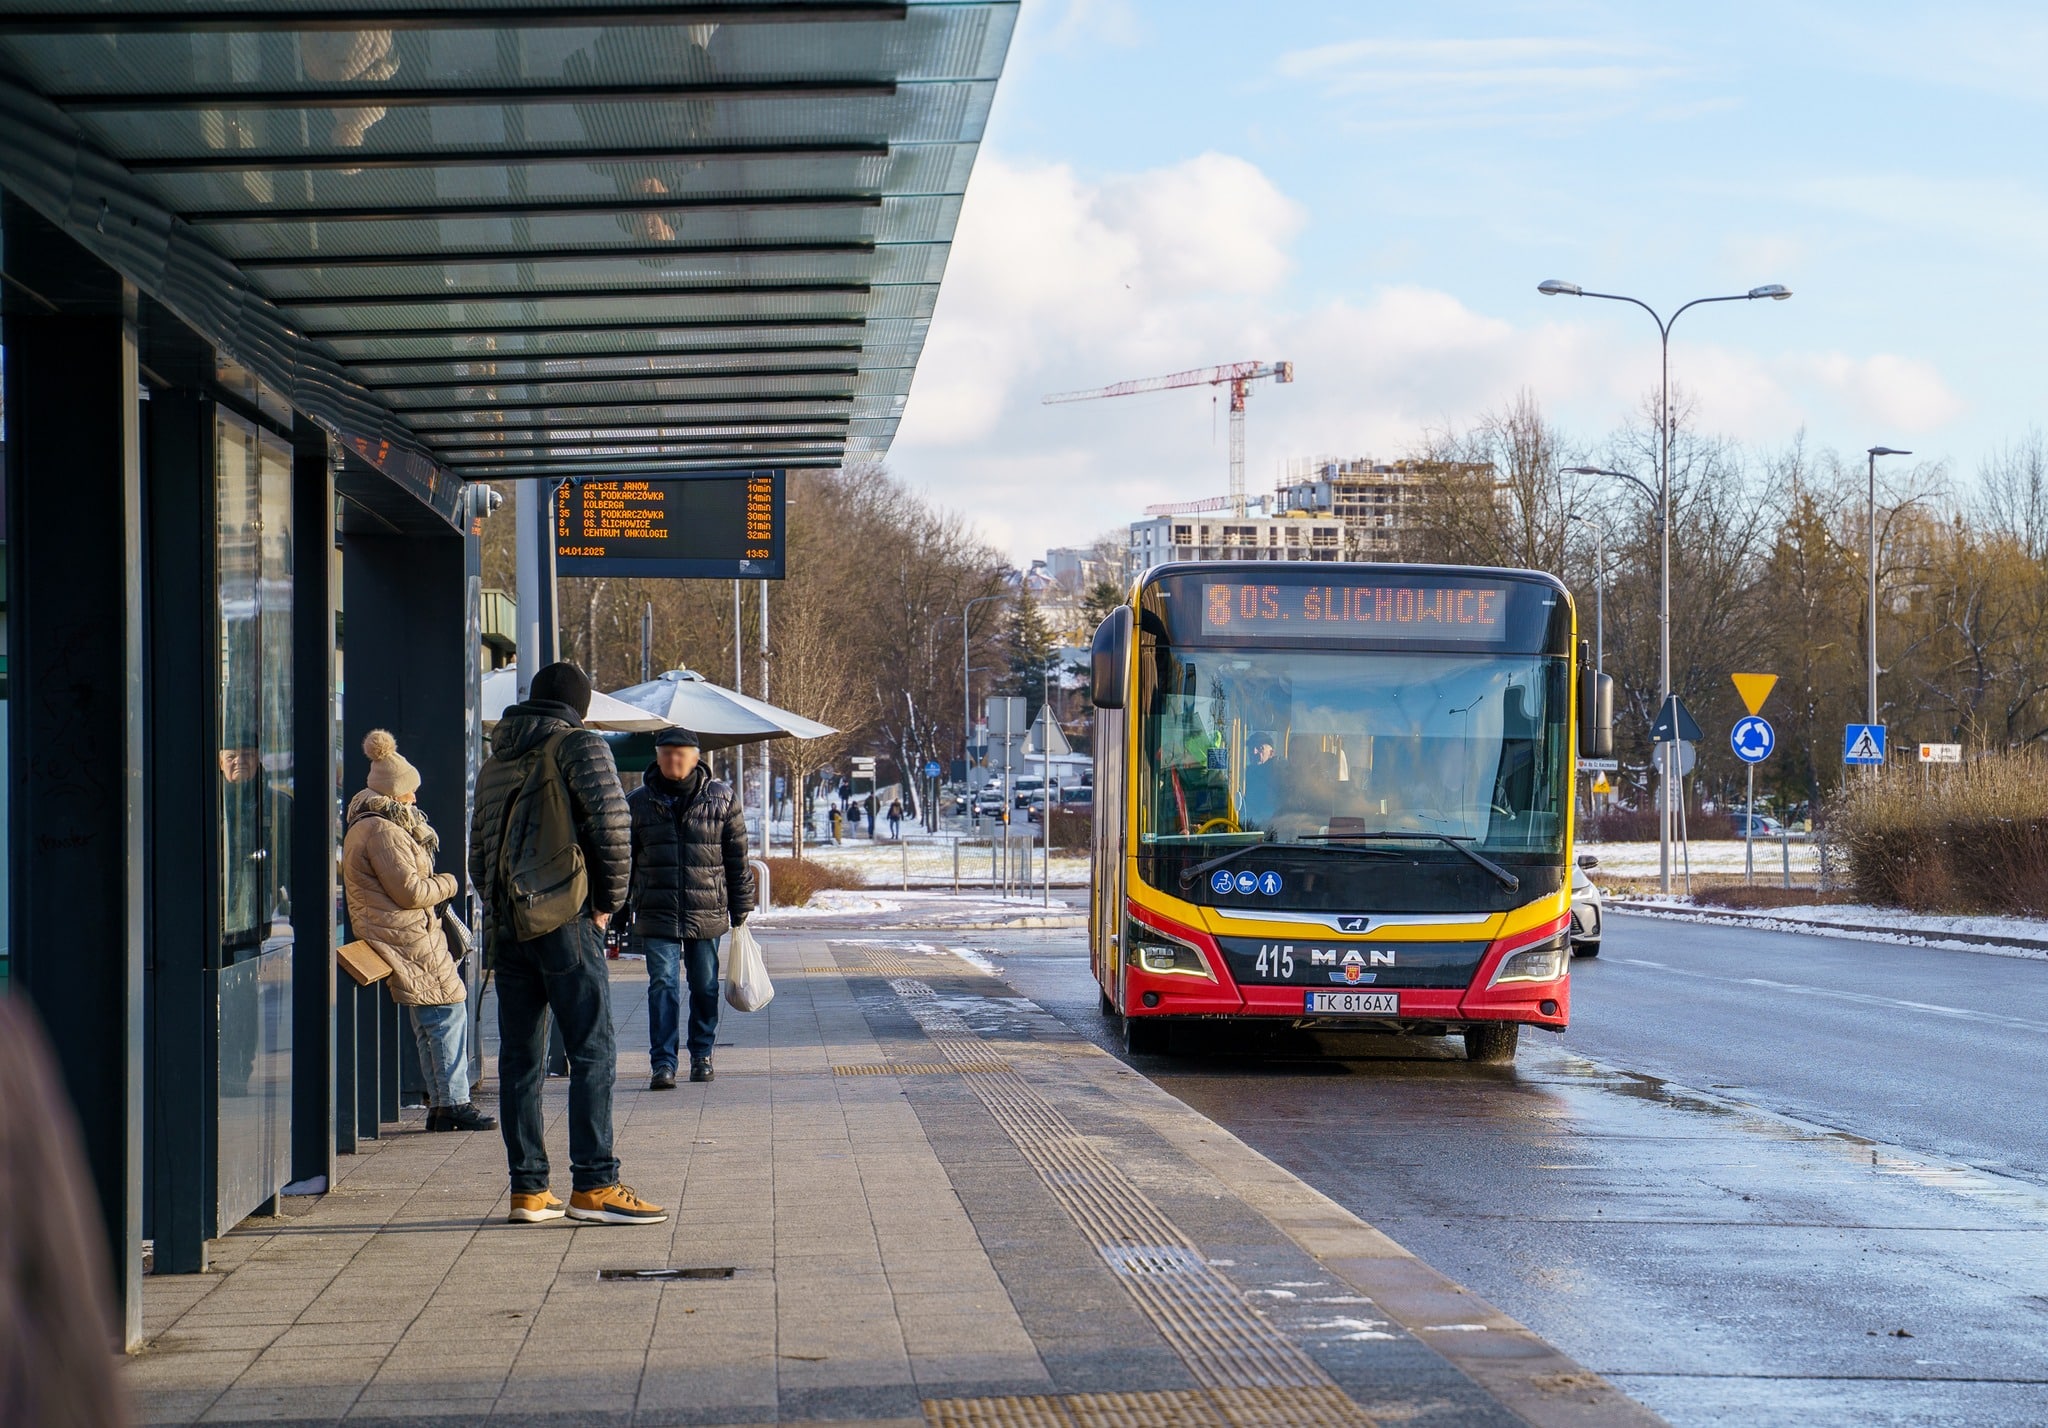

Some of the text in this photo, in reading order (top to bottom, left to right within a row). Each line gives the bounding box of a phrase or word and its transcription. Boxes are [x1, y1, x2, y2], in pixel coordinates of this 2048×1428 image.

[748, 484, 772, 493] 10min
[559, 490, 772, 502] 35 OS. PODKARCZÓWKA 14min
[559, 499, 772, 512] 2 KOLBERGA 30min
[559, 509, 772, 521] 35 OS. PODKARCZÓWKA 30min
[559, 518, 772, 531] 8 OS. ŚLICHOWICE 31min
[559, 527, 772, 540] 51 CENTRUM ONKOLOGII 32min
[559, 547, 769, 559] 04.01.2025 13:53
[1208, 584, 1231, 625] 8
[1240, 585, 1289, 619] OS.
[1255, 945, 1294, 978] 415
[1311, 949, 1396, 966] MAN
[1317, 994, 1337, 1010] TK
[1343, 995, 1393, 1012] 816AX
